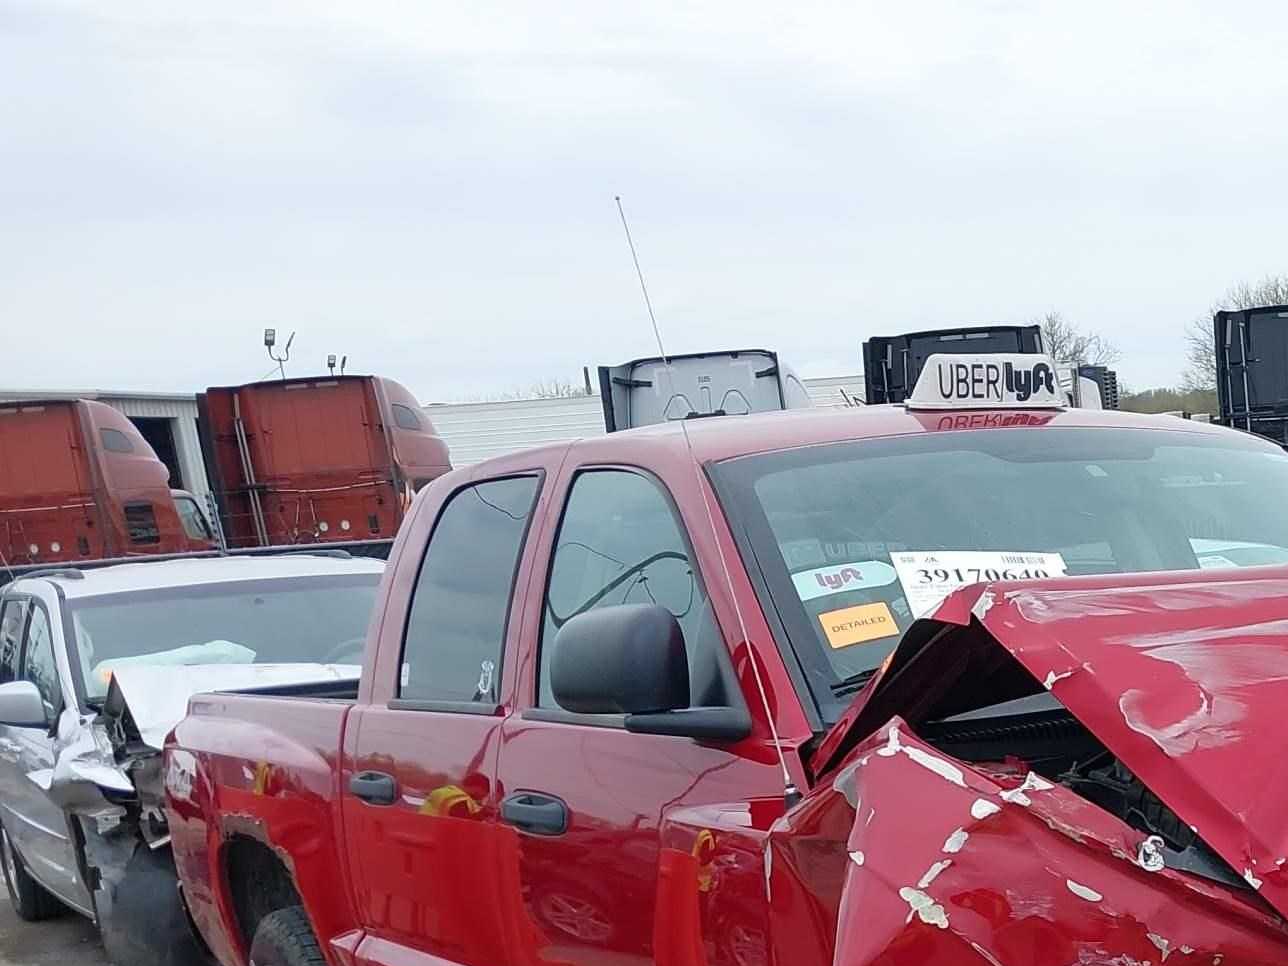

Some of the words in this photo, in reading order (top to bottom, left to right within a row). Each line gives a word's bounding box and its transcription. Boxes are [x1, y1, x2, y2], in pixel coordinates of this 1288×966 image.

[938, 362, 1000, 399] UBER
[1004, 362, 1054, 401] lyft
[814, 567, 864, 590] lyft
[831, 615, 887, 633] DETAILED
